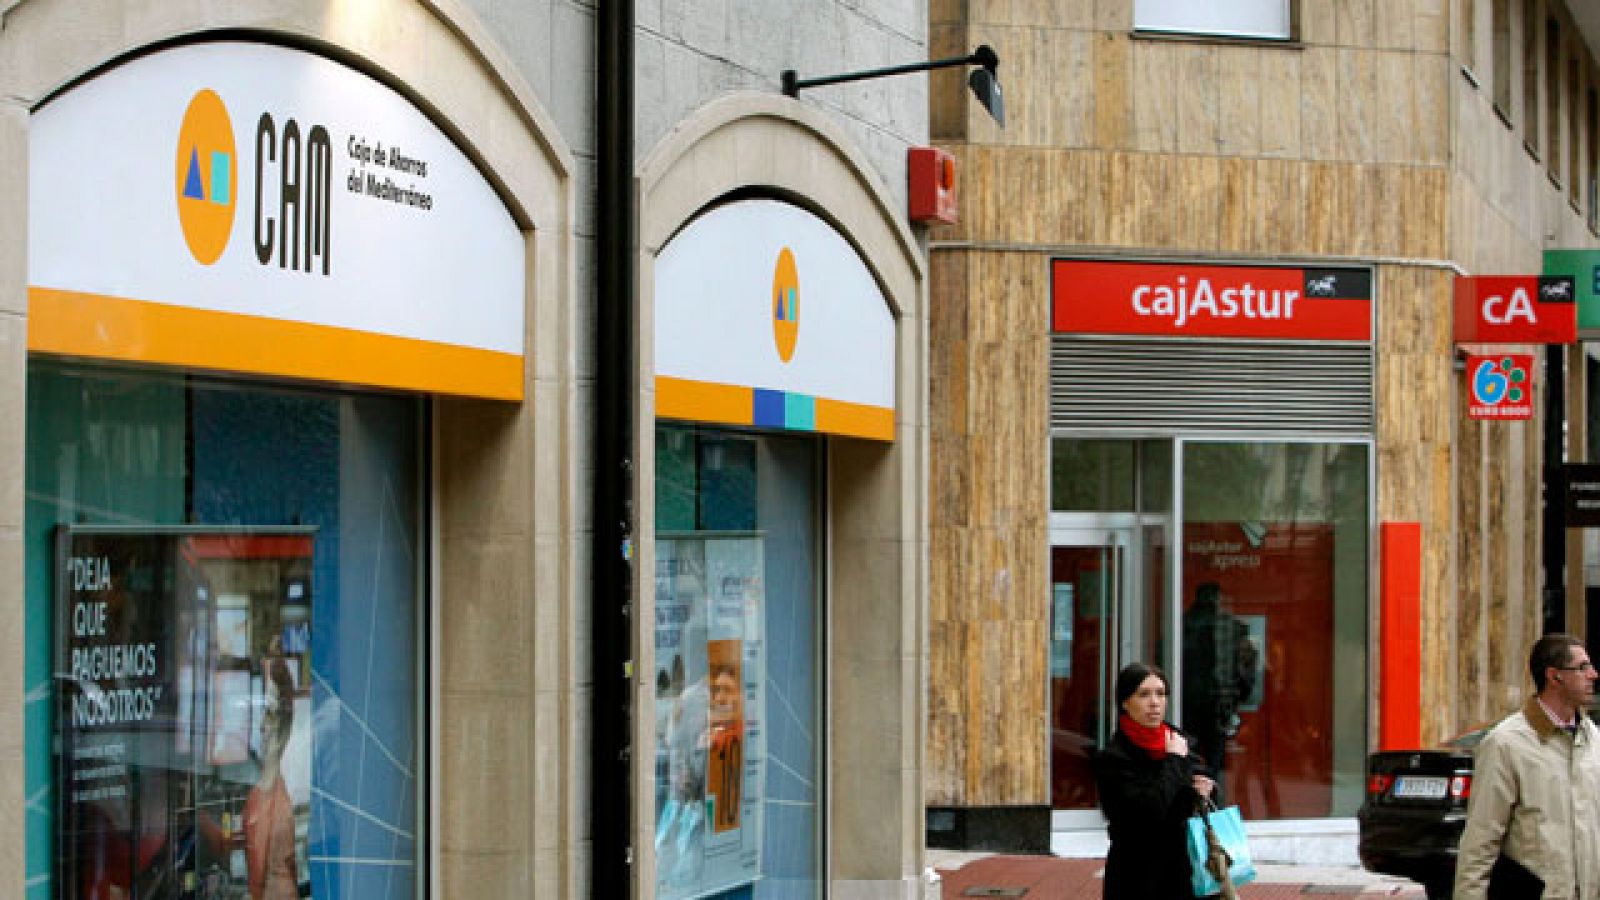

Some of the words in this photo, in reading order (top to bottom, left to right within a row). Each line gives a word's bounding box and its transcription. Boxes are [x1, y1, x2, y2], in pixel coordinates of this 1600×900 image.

[347, 134, 370, 168] Caja
[374, 141, 385, 165] de
[389, 147, 427, 178] Ahorros
[255, 111, 331, 276] CAM
[347, 168, 365, 194] del
[1132, 275, 1299, 326] cajAstur
[1482, 287, 1537, 325] cA
[74, 601, 108, 636] QUE
[72, 642, 156, 681] PAGUEMOS
